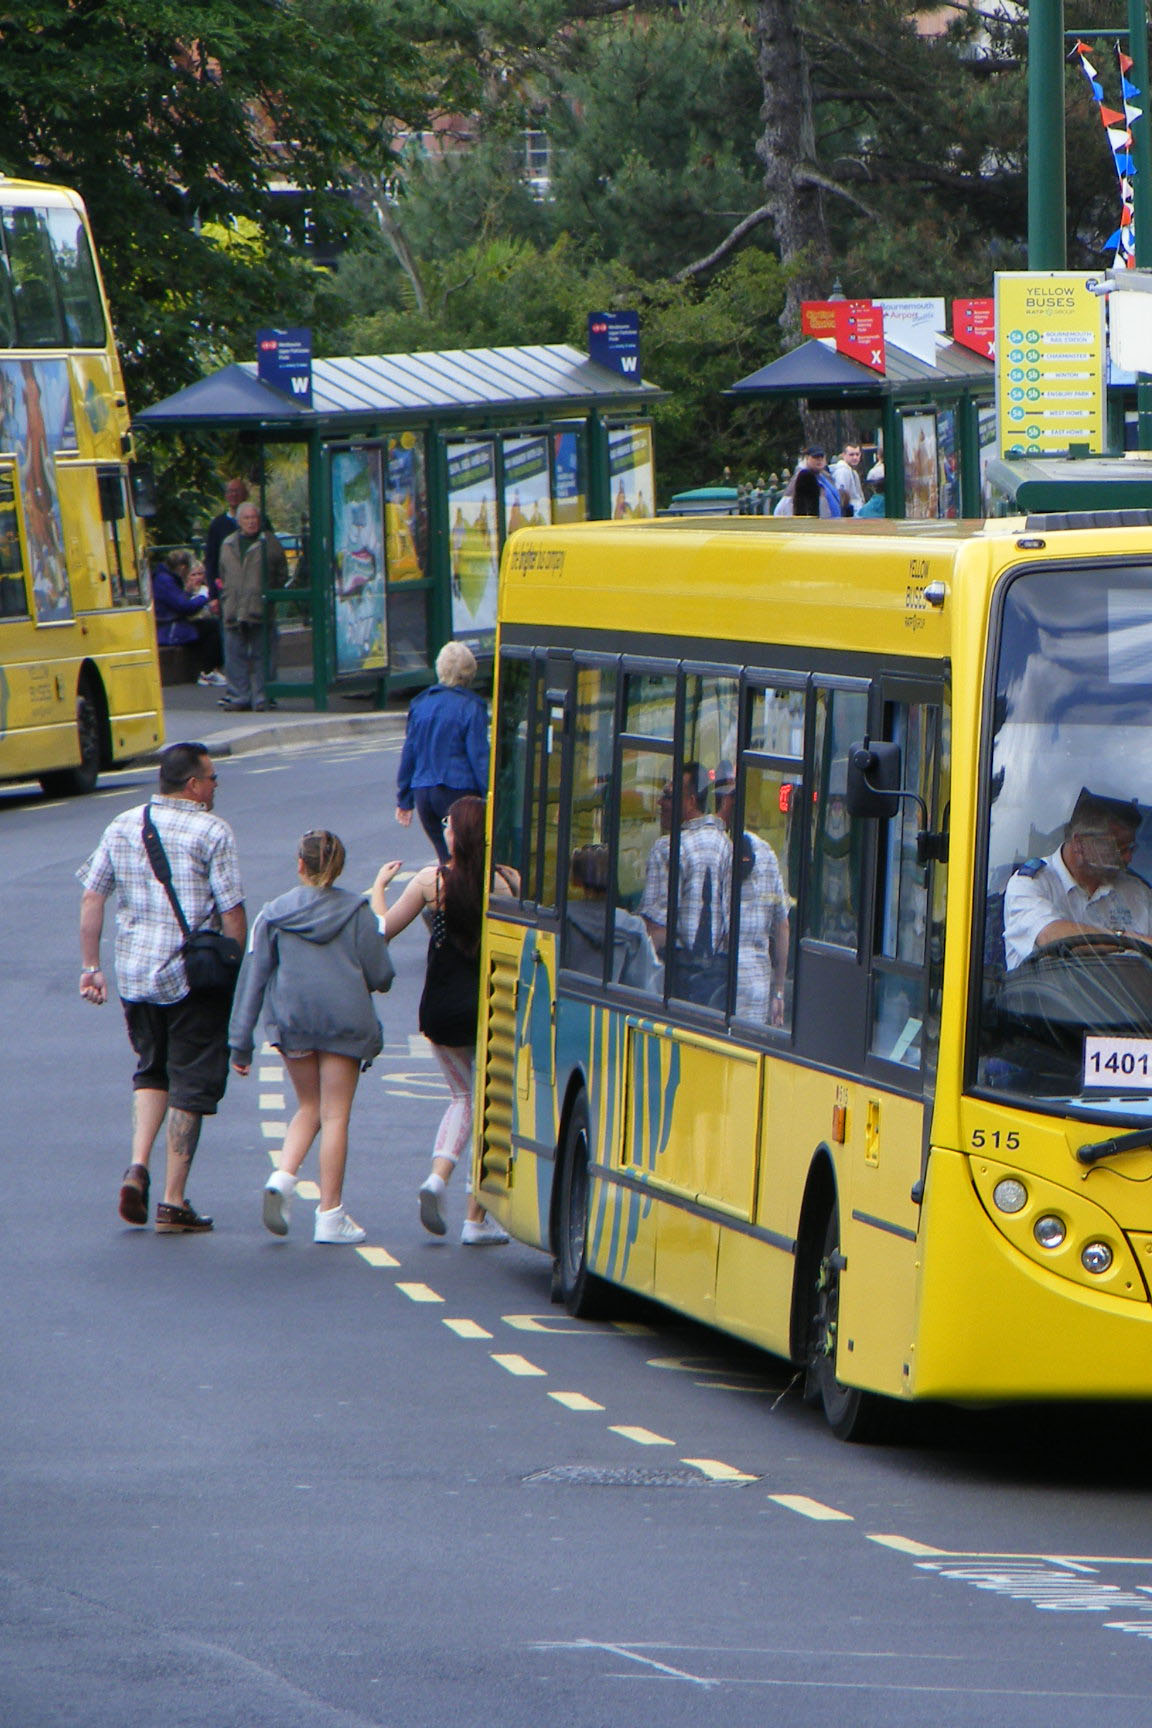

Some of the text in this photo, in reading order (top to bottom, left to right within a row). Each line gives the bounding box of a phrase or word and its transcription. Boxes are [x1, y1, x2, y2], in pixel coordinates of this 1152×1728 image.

[1026, 287, 1075, 296] YELLOW
[880, 302, 934, 311] Bournemouth
[1026, 297, 1075, 307] BUSES
[890, 311, 919, 322] Airport
[621, 356, 638, 372] W
[871, 350, 882, 365] X
[290, 377, 309, 394] W
[1090, 1051, 1149, 1075] 1401
[971, 1129, 1020, 1150] 515
